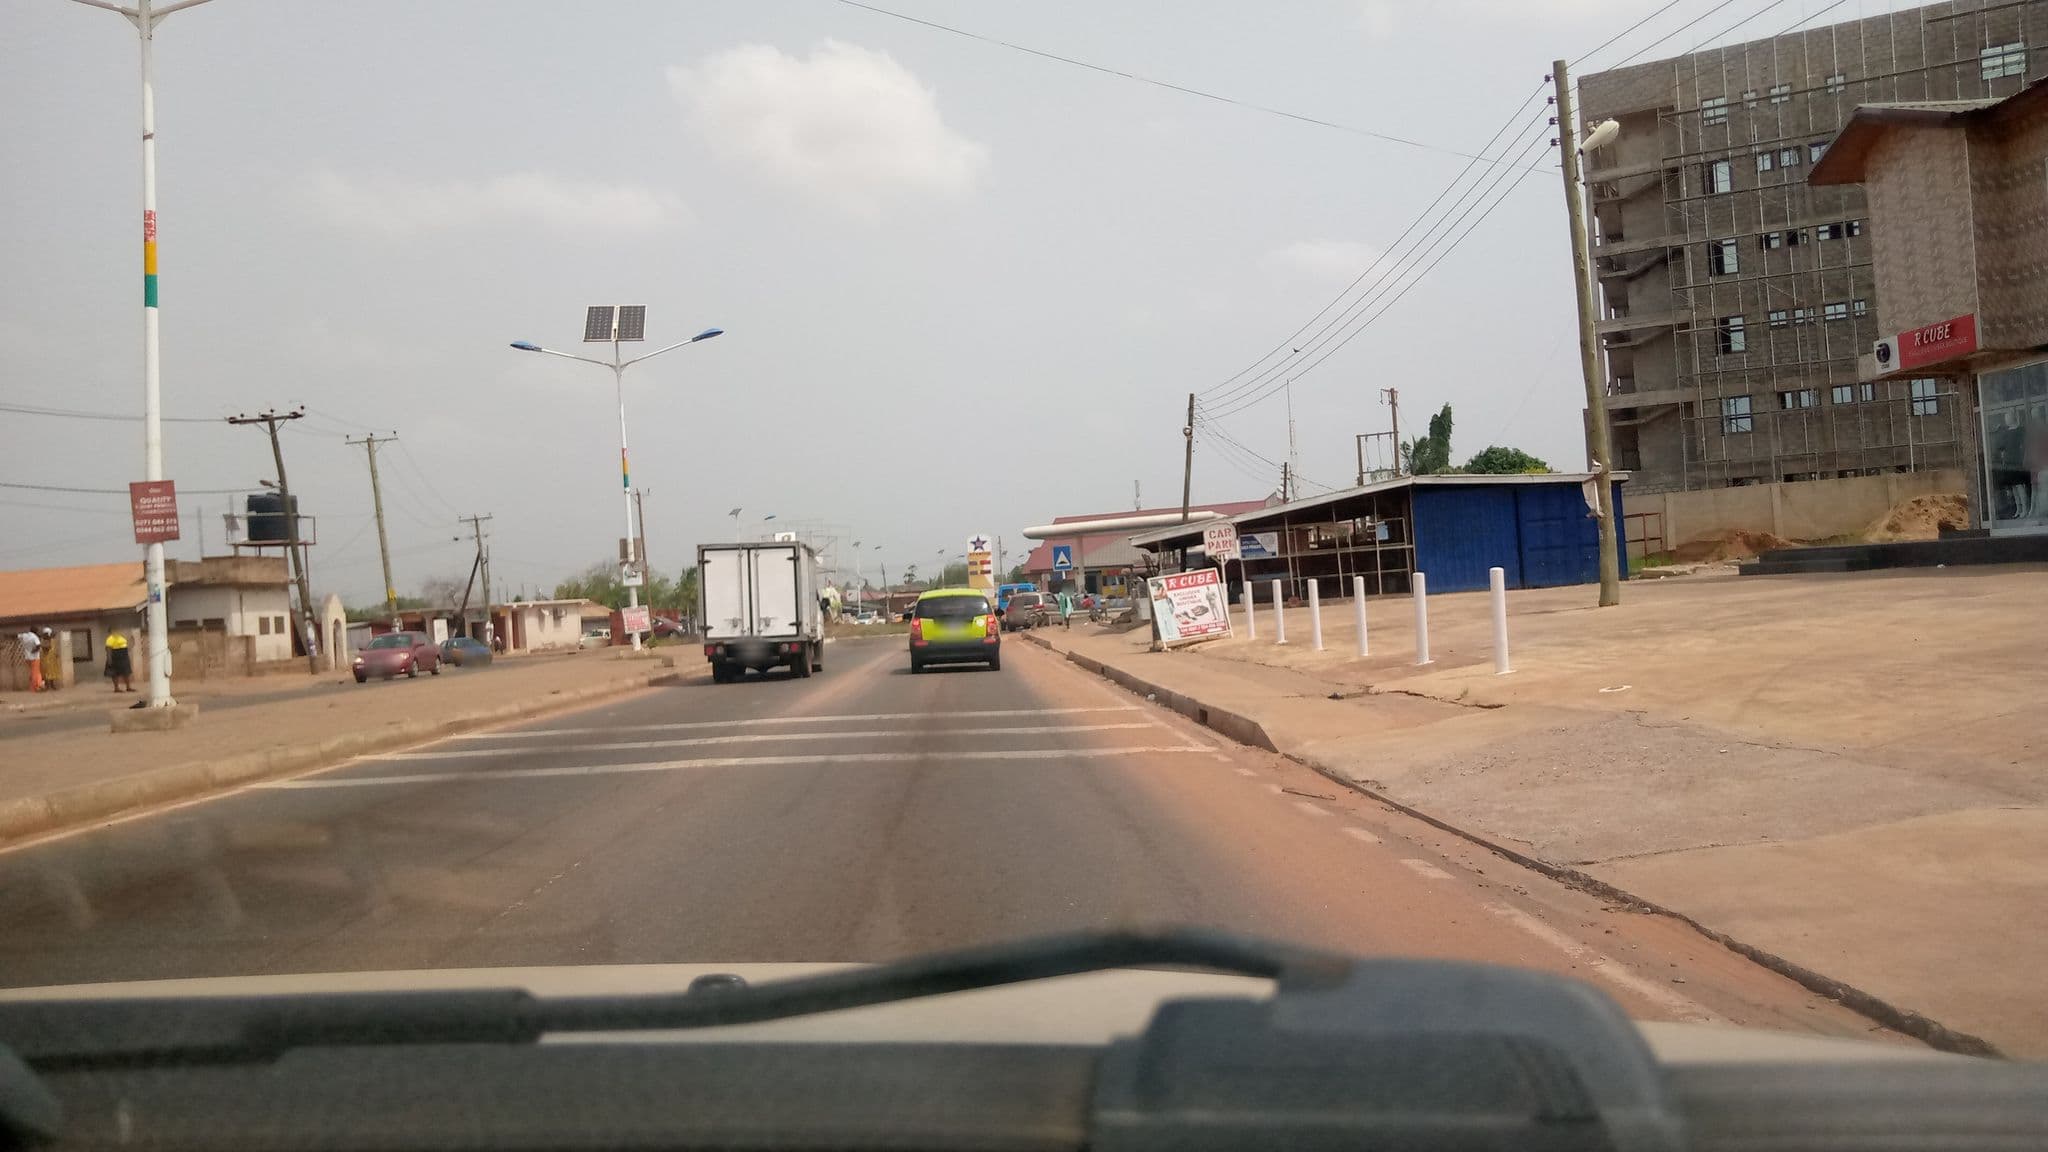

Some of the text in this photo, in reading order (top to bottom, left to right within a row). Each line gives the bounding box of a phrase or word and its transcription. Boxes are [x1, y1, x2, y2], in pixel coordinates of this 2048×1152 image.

[1914, 324, 1951, 347] R CUBE
[1208, 528, 1232, 539] CAR
[1168, 572, 1214, 589] R CUBE
